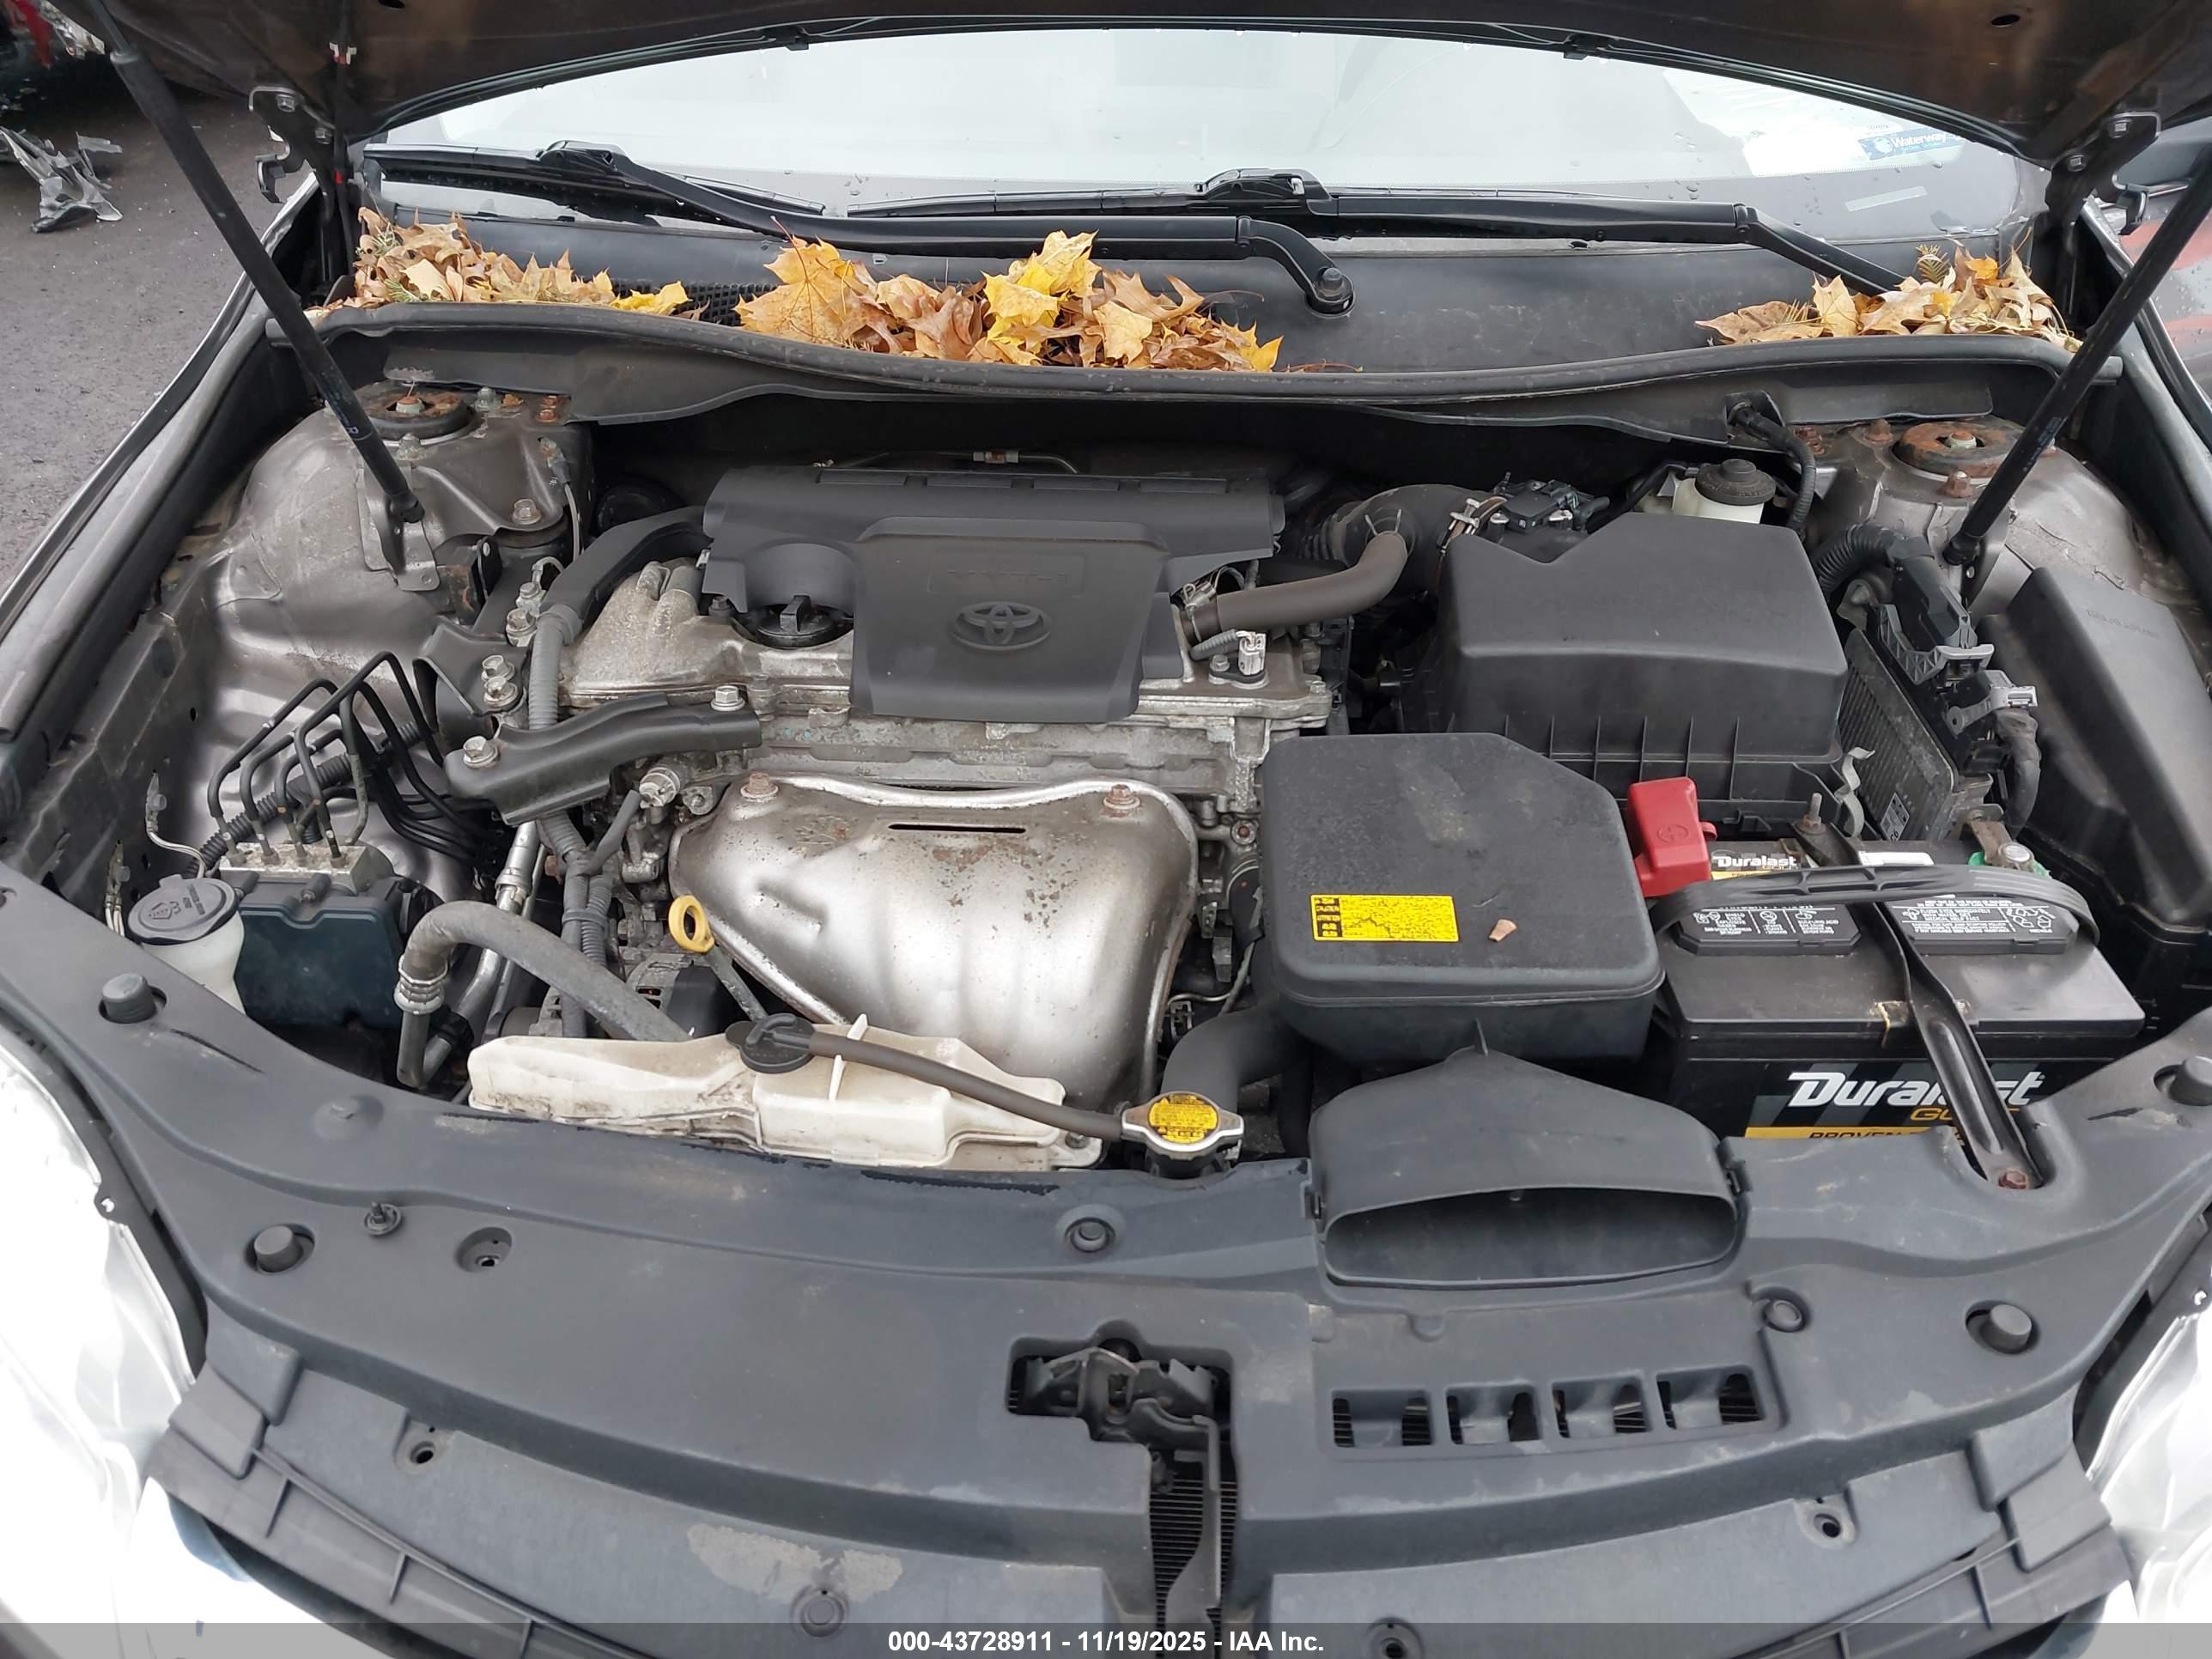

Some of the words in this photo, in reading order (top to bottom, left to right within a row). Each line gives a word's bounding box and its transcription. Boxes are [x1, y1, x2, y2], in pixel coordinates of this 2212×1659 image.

[1890, 133, 1948, 148] Waterway
[1713, 855, 1797, 867] Duralast
[1787, 1072, 2043, 1107] Duralst
